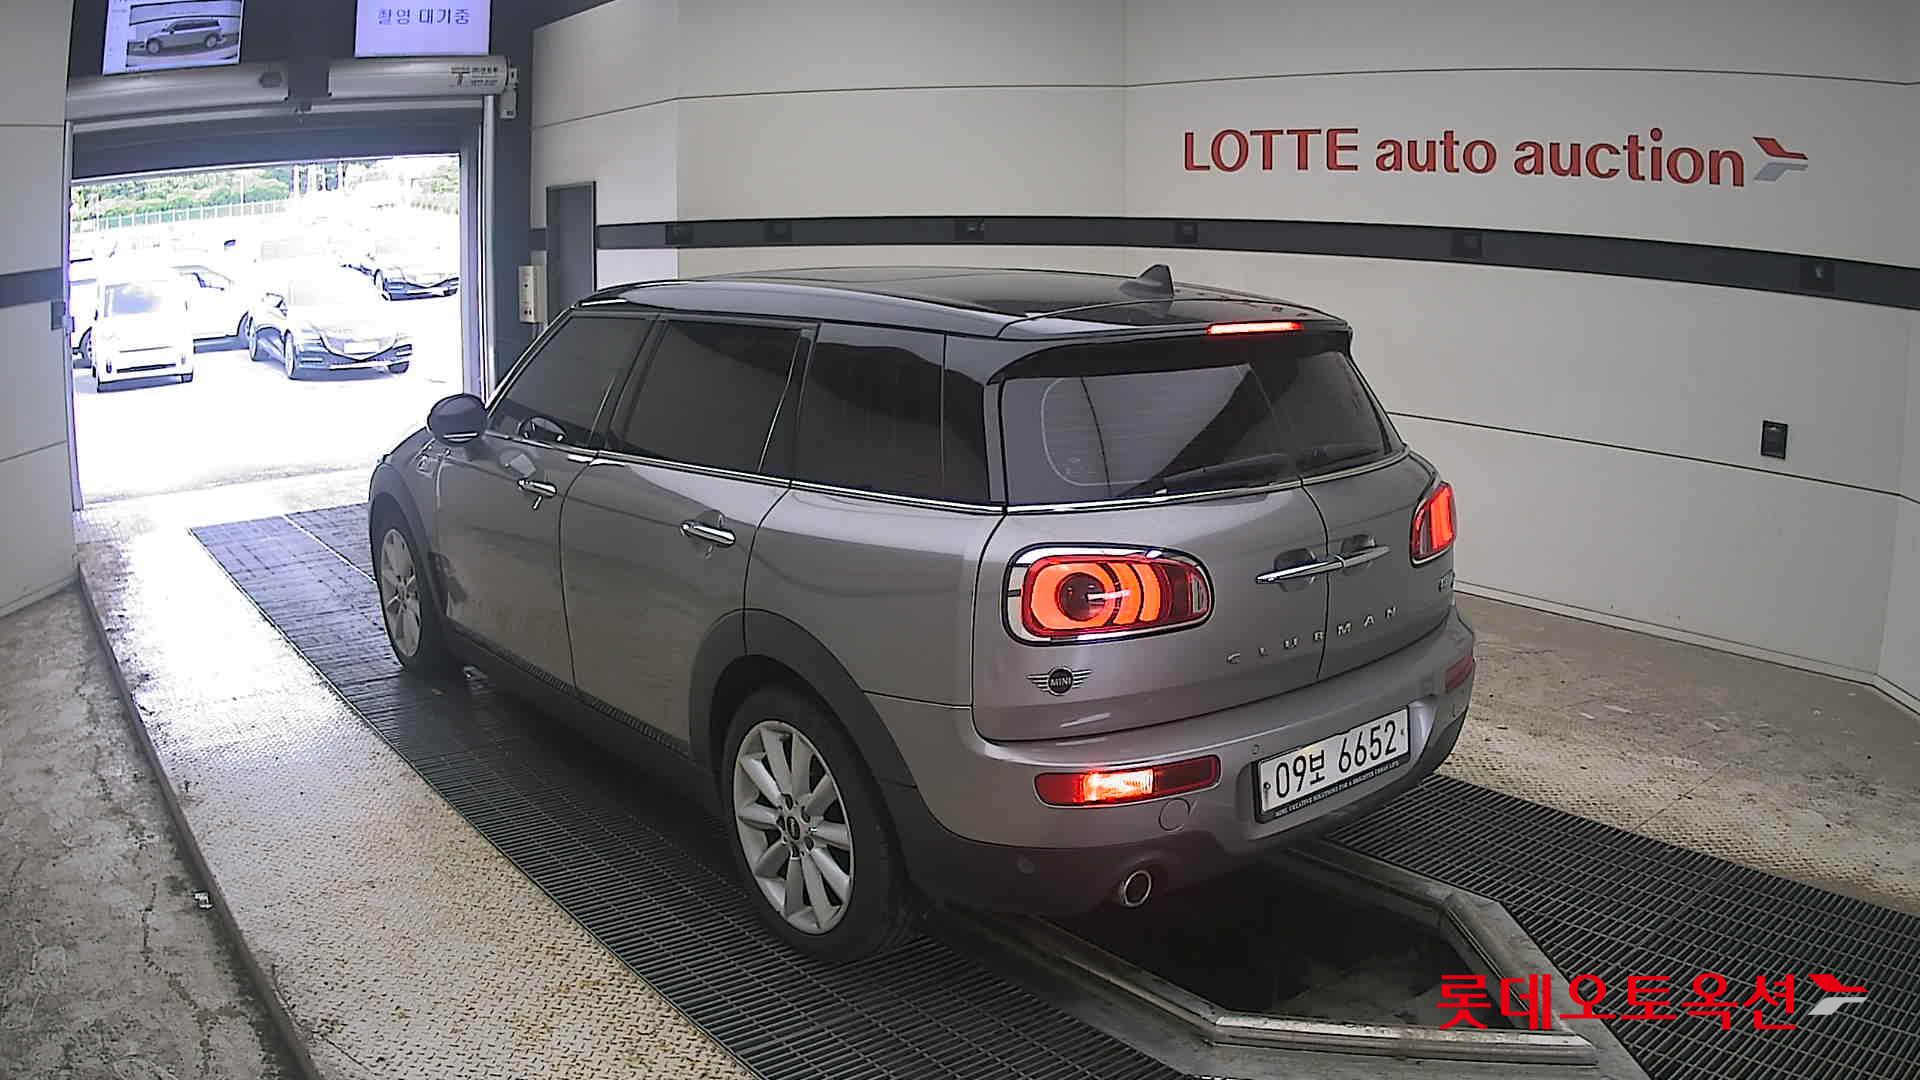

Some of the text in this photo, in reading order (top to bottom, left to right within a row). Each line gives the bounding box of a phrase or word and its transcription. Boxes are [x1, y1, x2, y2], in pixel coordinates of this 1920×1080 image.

[419, 8, 470, 25] 대기중
[1184, 127, 1746, 188] LOTTE auto auction
[1226, 606, 1400, 665] CLUBMAN
[1050, 676, 1072, 688] MINI
[1275, 719, 1398, 799] 09보 6652
